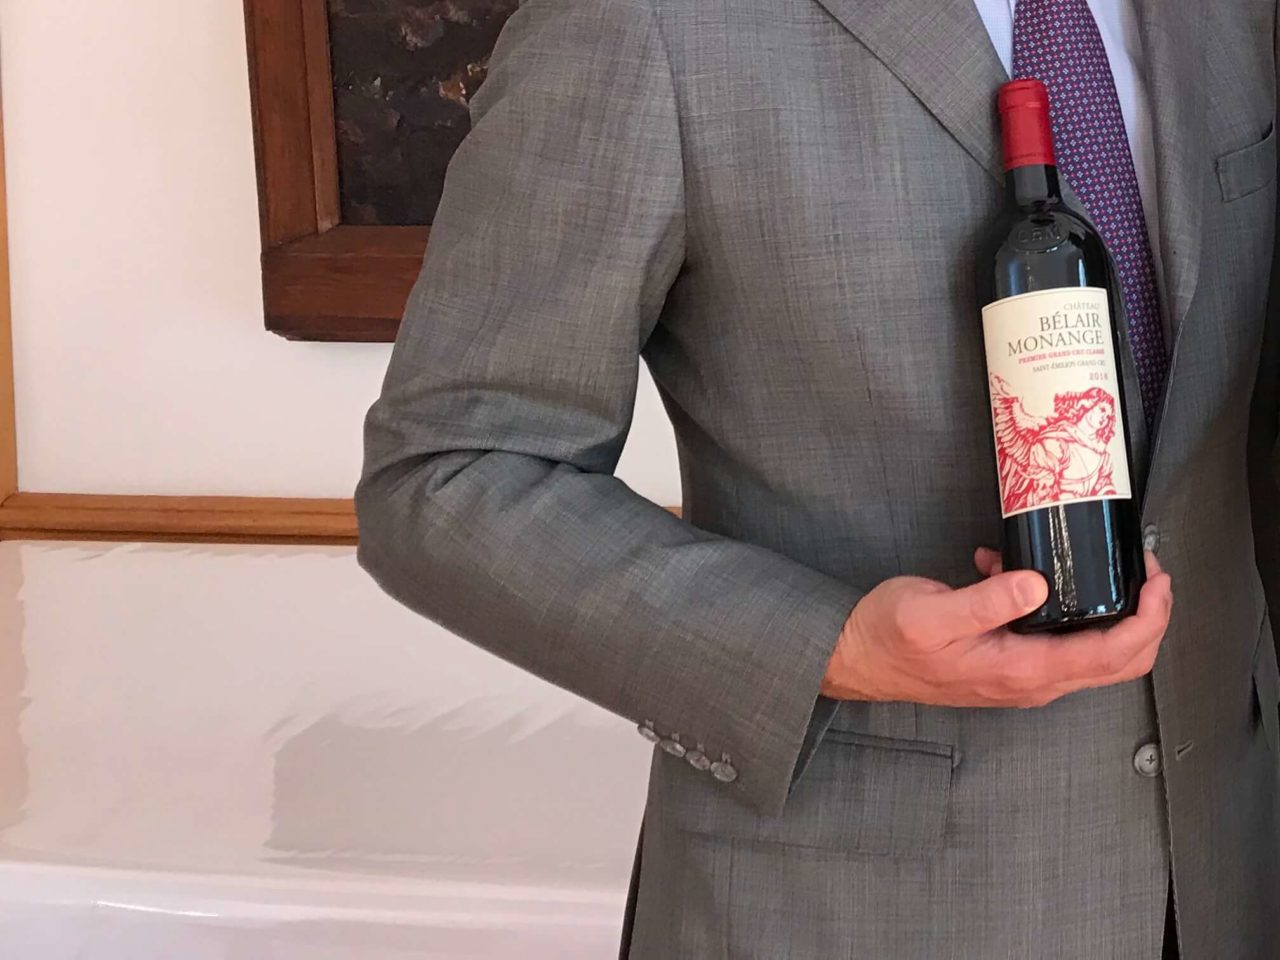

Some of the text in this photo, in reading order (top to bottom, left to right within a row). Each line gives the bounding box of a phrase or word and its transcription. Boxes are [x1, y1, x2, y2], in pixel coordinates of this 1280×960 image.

[1039, 311, 1102, 332] BÉLAIR
[1007, 330, 1104, 357] MONANGE
[1048, 350, 1071, 359] GRAND
